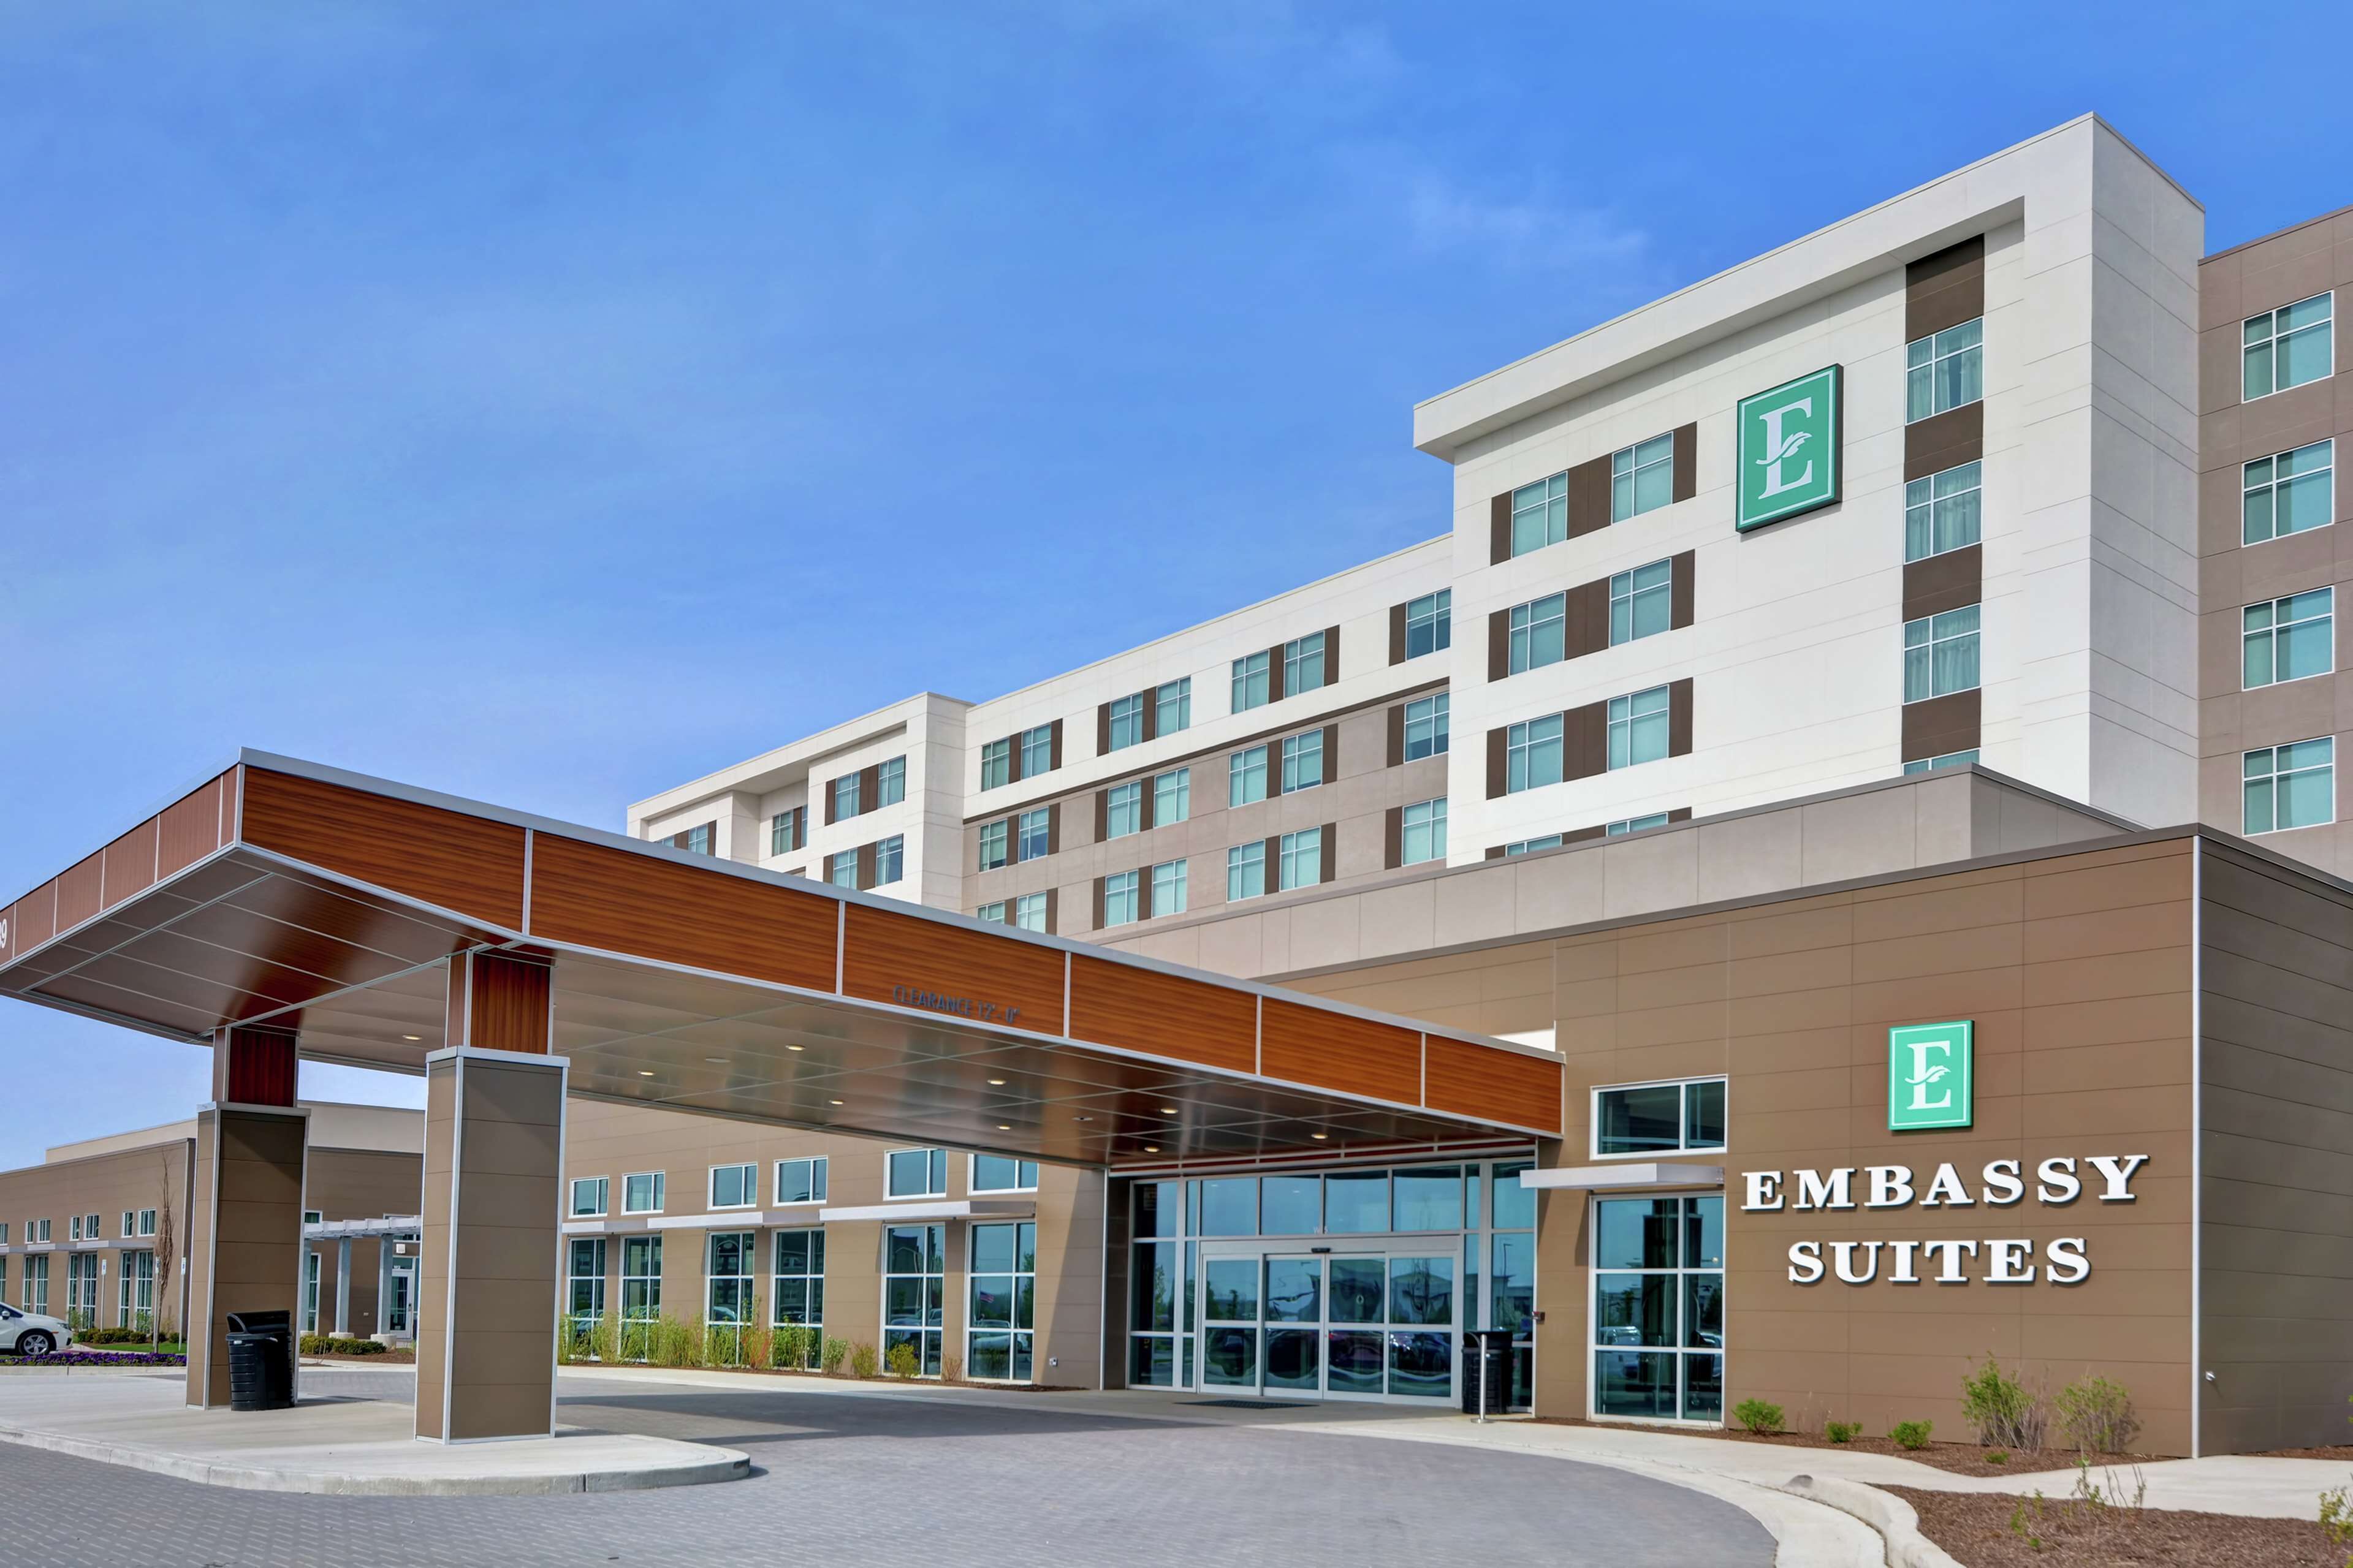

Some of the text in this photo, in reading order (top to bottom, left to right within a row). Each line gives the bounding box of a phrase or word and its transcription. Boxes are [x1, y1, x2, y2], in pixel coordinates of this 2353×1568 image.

[1755, 396, 1813, 500] E
[0, 918, 7, 950] 9
[893, 985, 972, 1017] CLEARANCE
[1905, 1040, 1952, 1110] E
[1741, 1154, 2150, 1211] EMBASSY
[1788, 1237, 2092, 1284] SUITES
